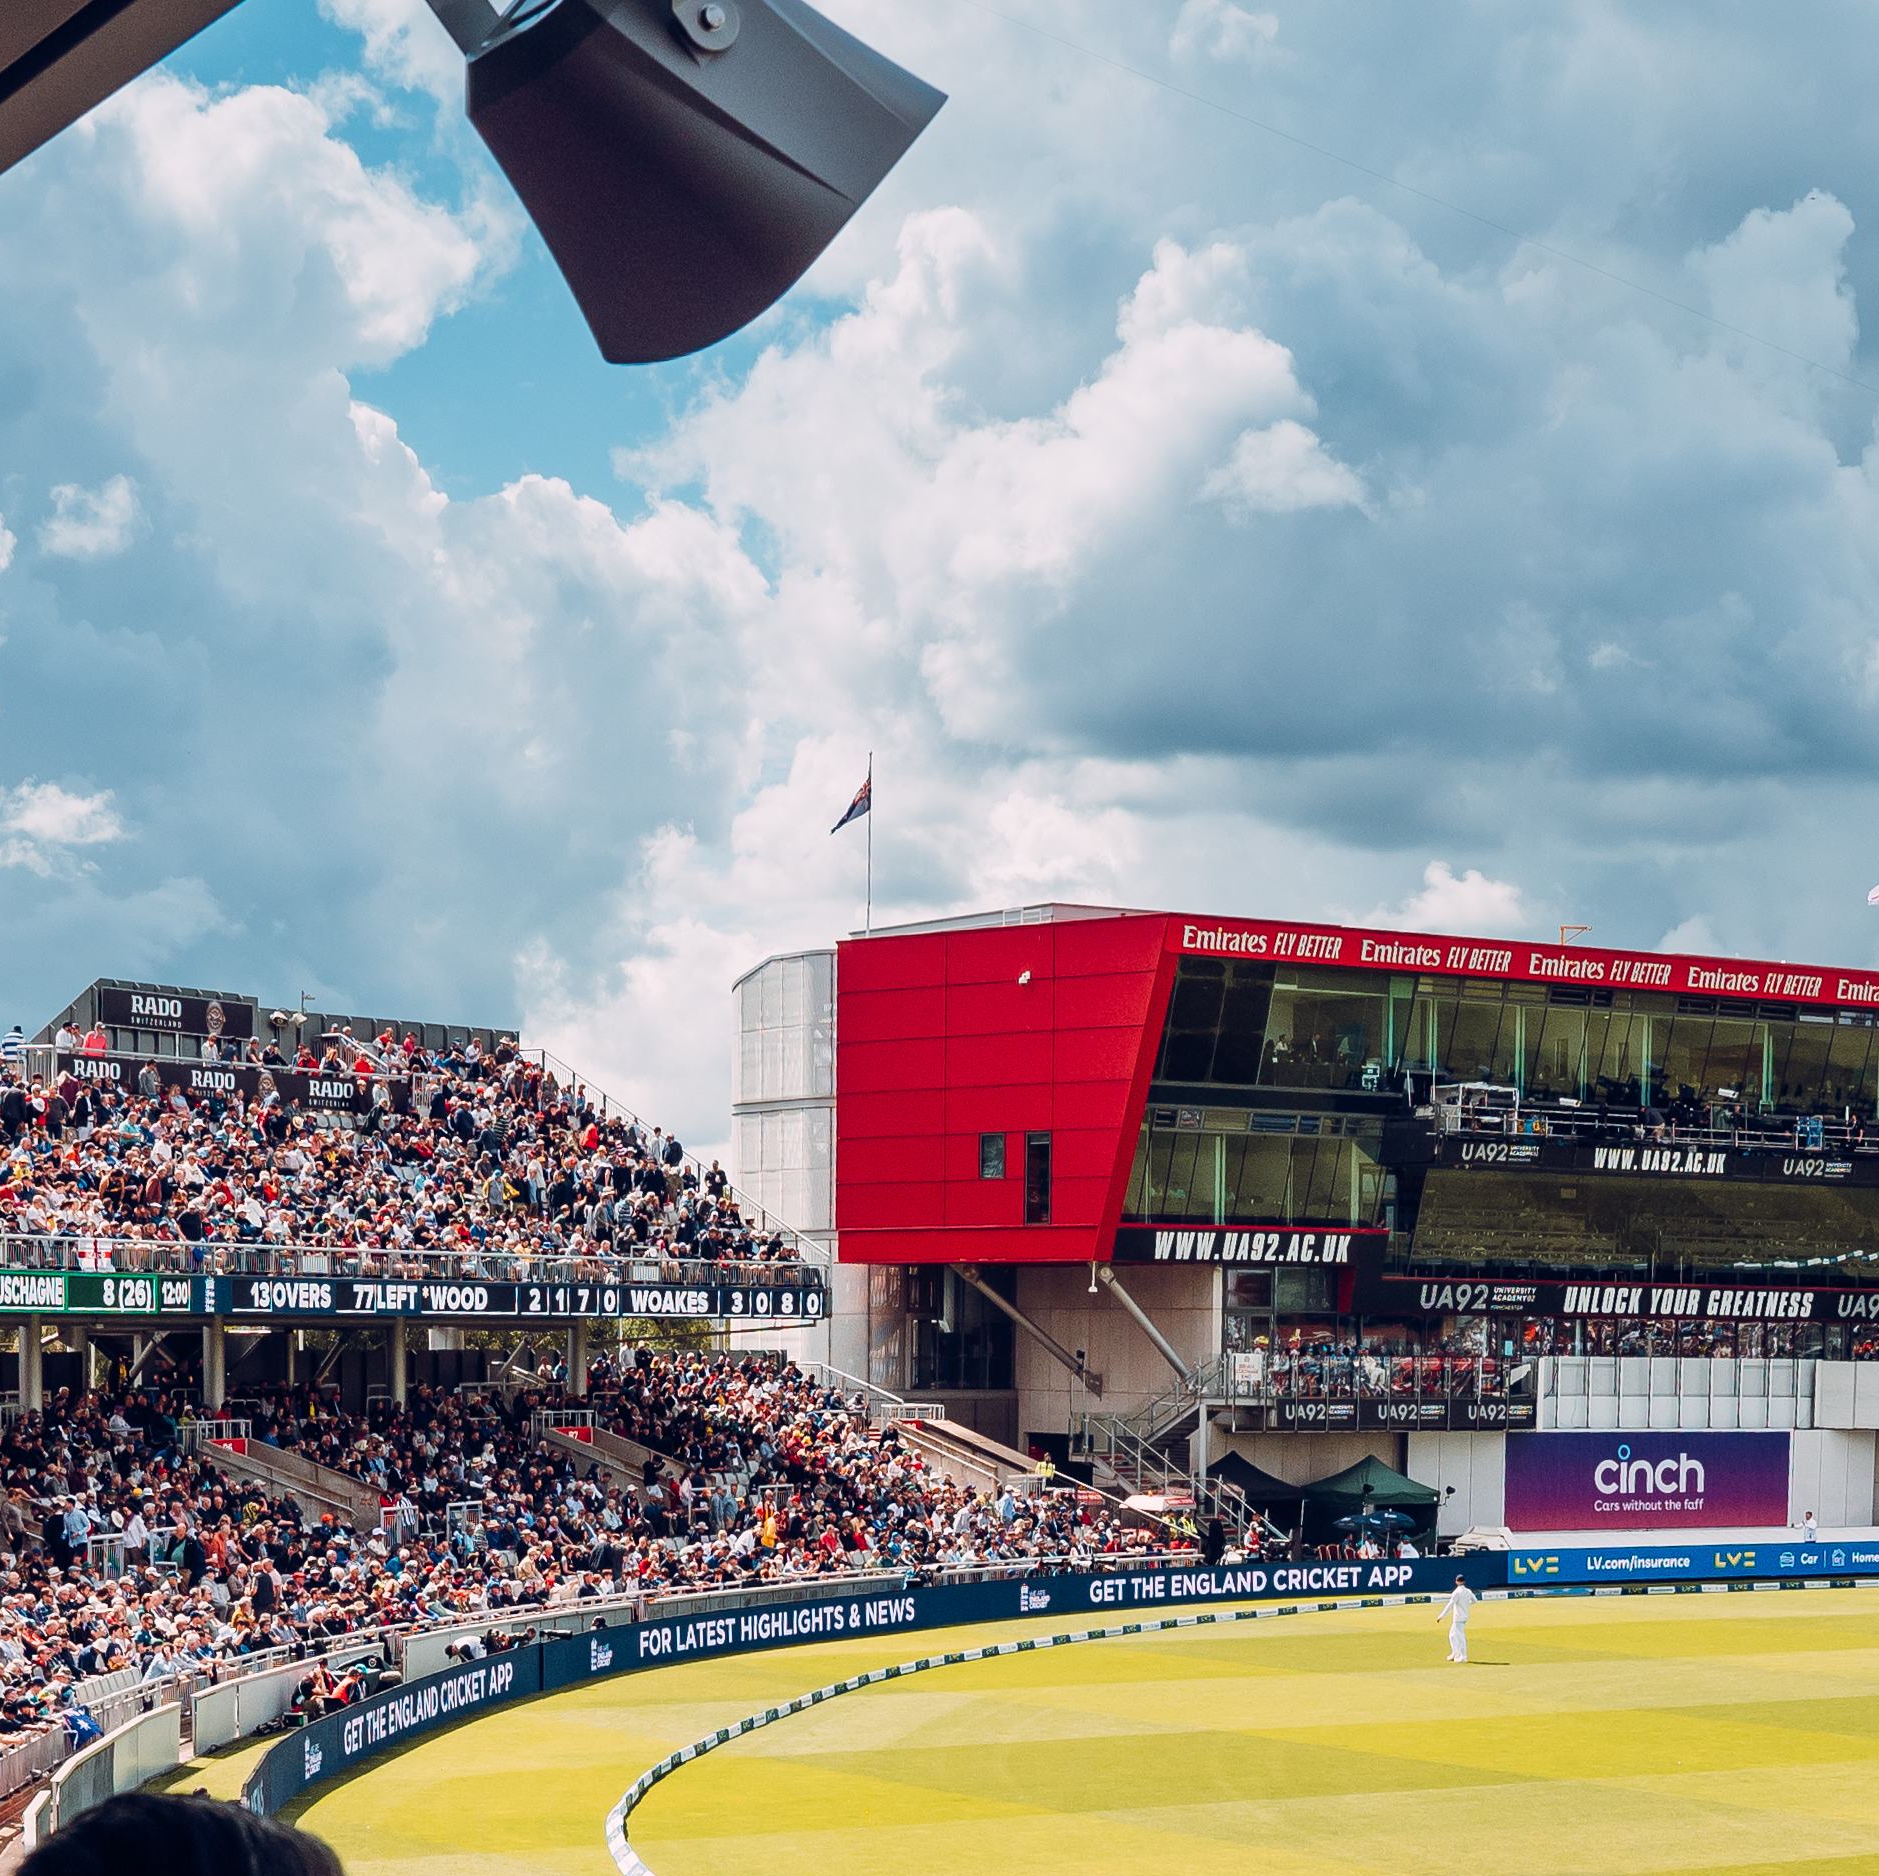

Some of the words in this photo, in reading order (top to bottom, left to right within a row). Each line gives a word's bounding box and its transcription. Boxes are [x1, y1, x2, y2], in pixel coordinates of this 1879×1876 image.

[1182, 924, 1268, 953] Emirates
[1273, 932, 1297, 956] FLY
[1296, 933, 1343, 960] BETTER
[1360, 939, 1441, 967] Emirates
[1446, 946, 1470, 970] FLY
[1468, 948, 1512, 973] BETTER
[1528, 953, 1605, 980] Emirates
[1609, 959, 1632, 982] FLY
[1630, 961, 1672, 985] BETTER
[1687, 966, 1759, 992] Emirates
[1763, 972, 1784, 994] FLY
[1783, 974, 1822, 998] BETTER
[131, 994, 182, 1018] RADO
[73, 1058, 121, 1080] RADO
[191, 1069, 235, 1090] RADO
[309, 1079, 353, 1099] RADO
[1461, 1143, 1508, 1162] UA92
[1594, 1147, 1726, 1174] WWW.UA92.AC.UK
[1782, 1158, 1825, 1177] UA92
[1154, 1231, 1351, 1263] WWW.UA92.AC.UK
[102, 1278, 115, 1306] 8
[118, 1279, 151, 1313] (26)
[161, 1280, 188, 1306] 12:00
[250, 1281, 270, 1308] 13
[273, 1282, 332, 1309] OVERS
[353, 1283, 374, 1310] 77
[377, 1284, 418, 1310] LEFT
[529, 1288, 541, 1312] 2
[555, 1289, 565, 1312] 1
[578, 1289, 591, 1312] 7
[604, 1290, 615, 1313] 0
[630, 1290, 709, 1313] WOAKES
[731, 1291, 743, 1313] 3
[756, 1292, 767, 1313] 0
[781, 1292, 793, 1314] 8
[807, 1292, 819, 1314] 0
[1420, 1284, 1490, 1311] UA92
[1562, 1286, 1643, 1314] UNLOCK
[1650, 1288, 1701, 1316] YOUR
[1706, 1289, 1814, 1318] GREATNESS
[1285, 1403, 1326, 1420] UA92
[1377, 1403, 1417, 1420] UA92
[1467, 1403, 1507, 1420] UA92
[1594, 1444, 1705, 1495] cinch
[1594, 1499, 1620, 1512] Cars
[1622, 1499, 1662, 1512] without
[1665, 1499, 1682, 1511] the
[1683, 1497, 1704, 1511] faff
[1586, 1555, 1691, 1572] LV.com/insurance
[1800, 1552, 1819, 1565] Car
[1851, 1552, 1879, 1564] Home
[1089, 1577, 1125, 1603] GET
[1131, 1574, 1166, 1599] THE
[1171, 1569, 1267, 1597] ENGLAND
[1273, 1565, 1362, 1591] CRICKET
[1367, 1564, 1414, 1588] APP
[639, 1627, 672, 1658] FOR
[676, 1618, 736, 1652] LATEST
[740, 1605, 844, 1643] HIGHLIGHTS
[849, 1603, 861, 1628] &
[865, 1597, 915, 1625] NEWS
[343, 1714, 364, 1756] GET
[366, 1707, 387, 1745] THE
[388, 1685, 438, 1734] ENGLAND
[440, 1668, 486, 1714] CRICKET
[489, 1661, 514, 1697] APP
